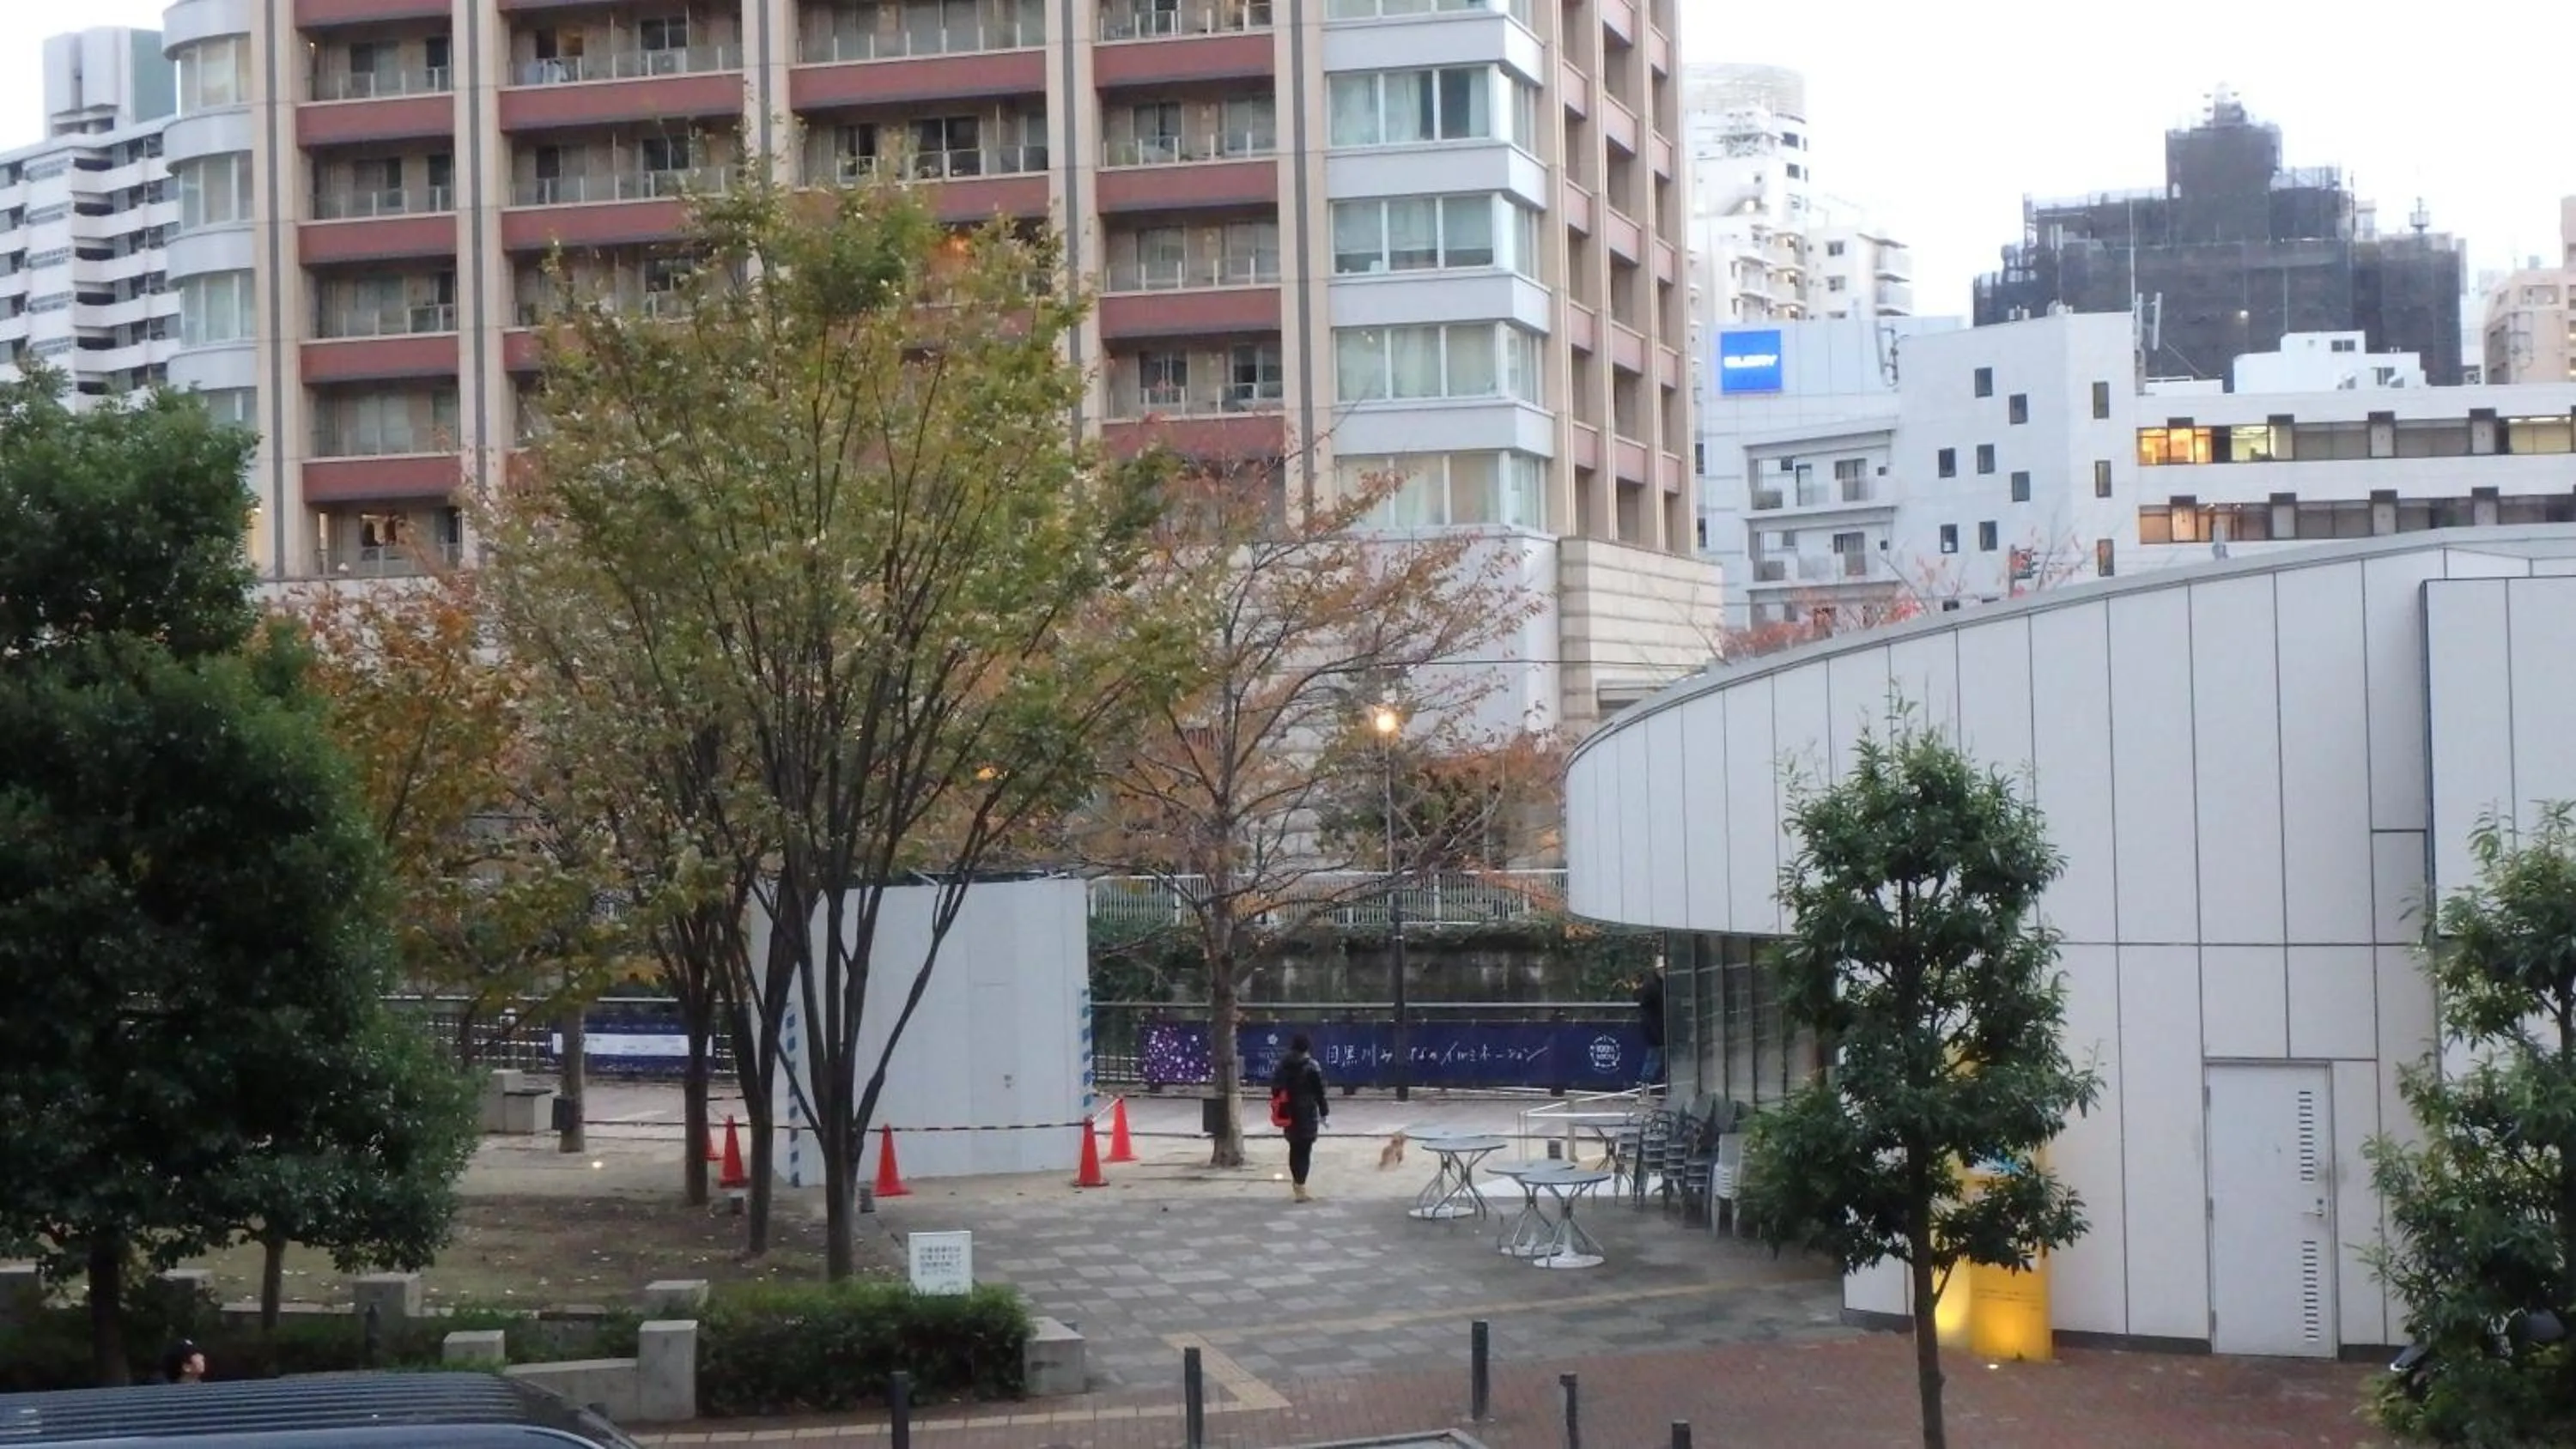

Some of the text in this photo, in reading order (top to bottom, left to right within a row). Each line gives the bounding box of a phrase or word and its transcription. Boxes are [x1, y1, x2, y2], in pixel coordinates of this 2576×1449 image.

[1326, 1040, 1548, 1066] 目黒川みなのイルミネーション
